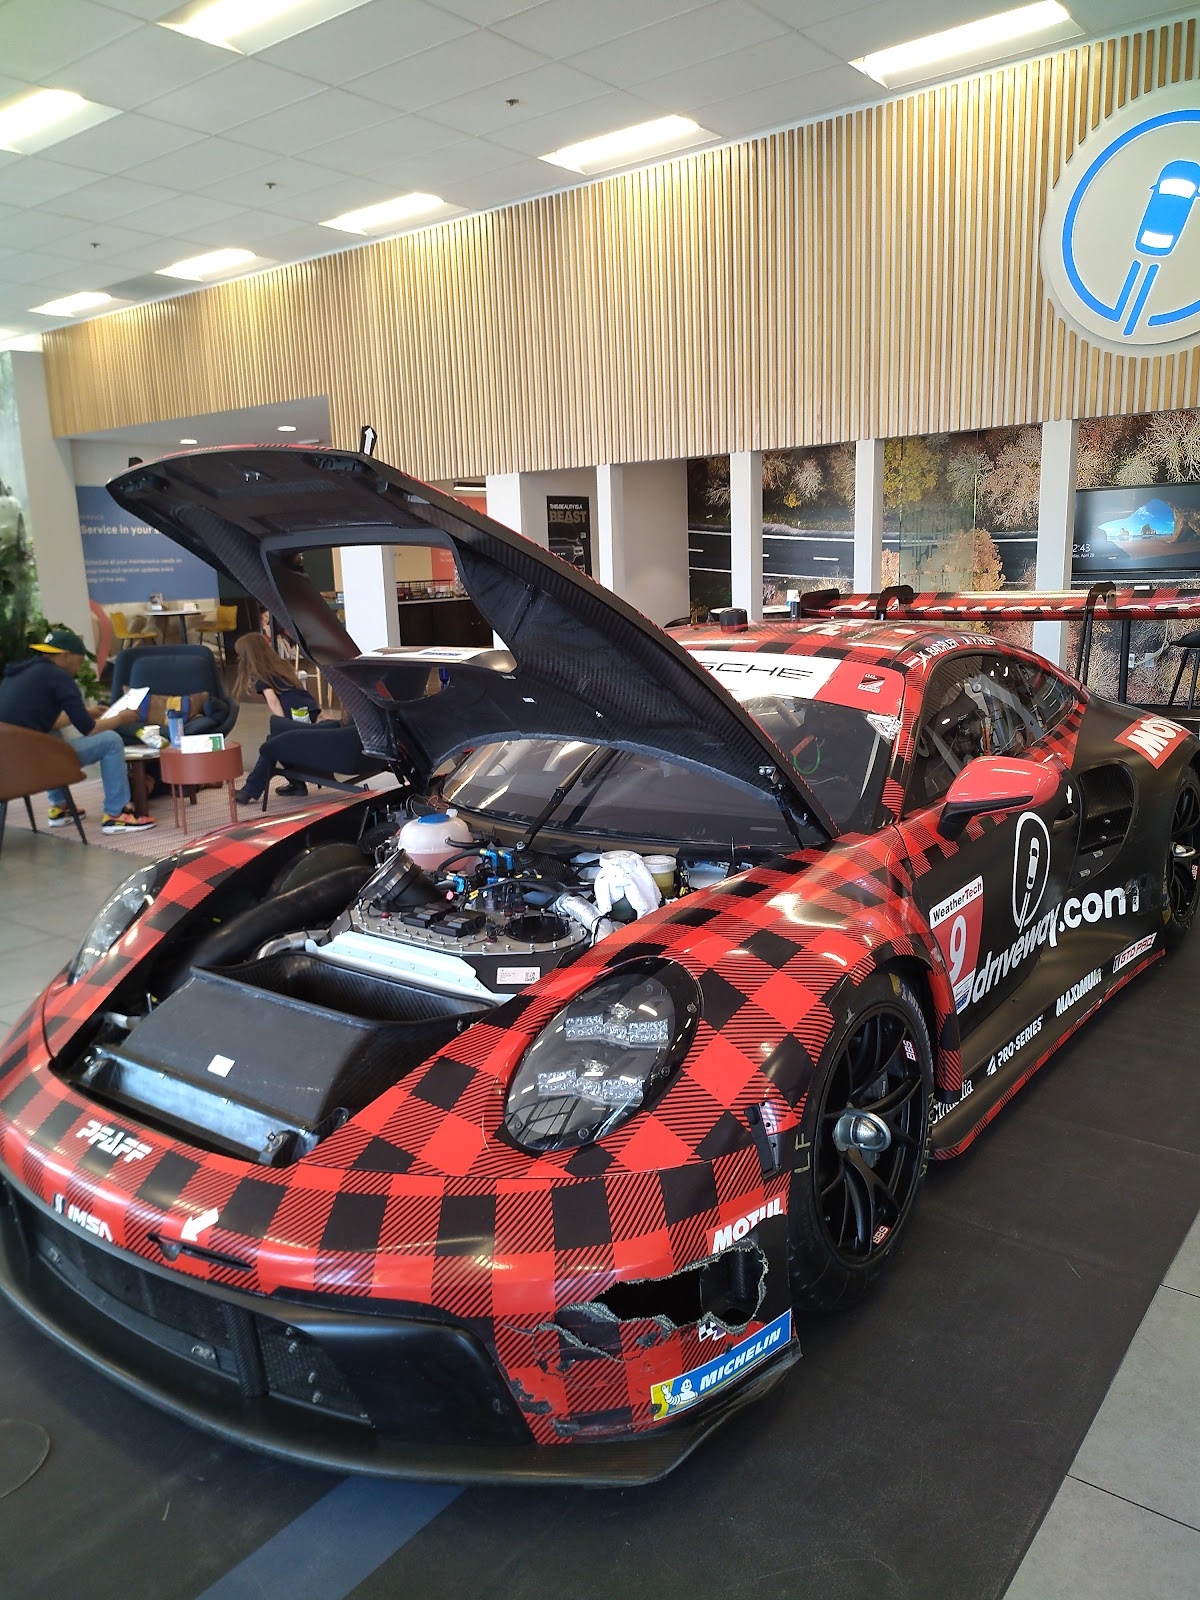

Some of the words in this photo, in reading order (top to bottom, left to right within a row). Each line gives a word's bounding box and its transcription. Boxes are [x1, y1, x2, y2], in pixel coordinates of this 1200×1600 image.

[80, 525, 118, 535] Service
[120, 524, 129, 534] in
[132, 526, 152, 536] your
[549, 511, 587, 523] BEAST
[932, 882, 982, 922] WeatherTech
[949, 914, 967, 986] 9
[972, 887, 1139, 1003] driveway.com
[903, 1039, 917, 1062] BBS
[76, 1120, 153, 1163] PFAFF
[793, 1132, 812, 1174] LF
[68, 1204, 114, 1243] IMSA
[873, 1225, 889, 1245] BBS
[699, 1326, 782, 1392] MICHELIN
